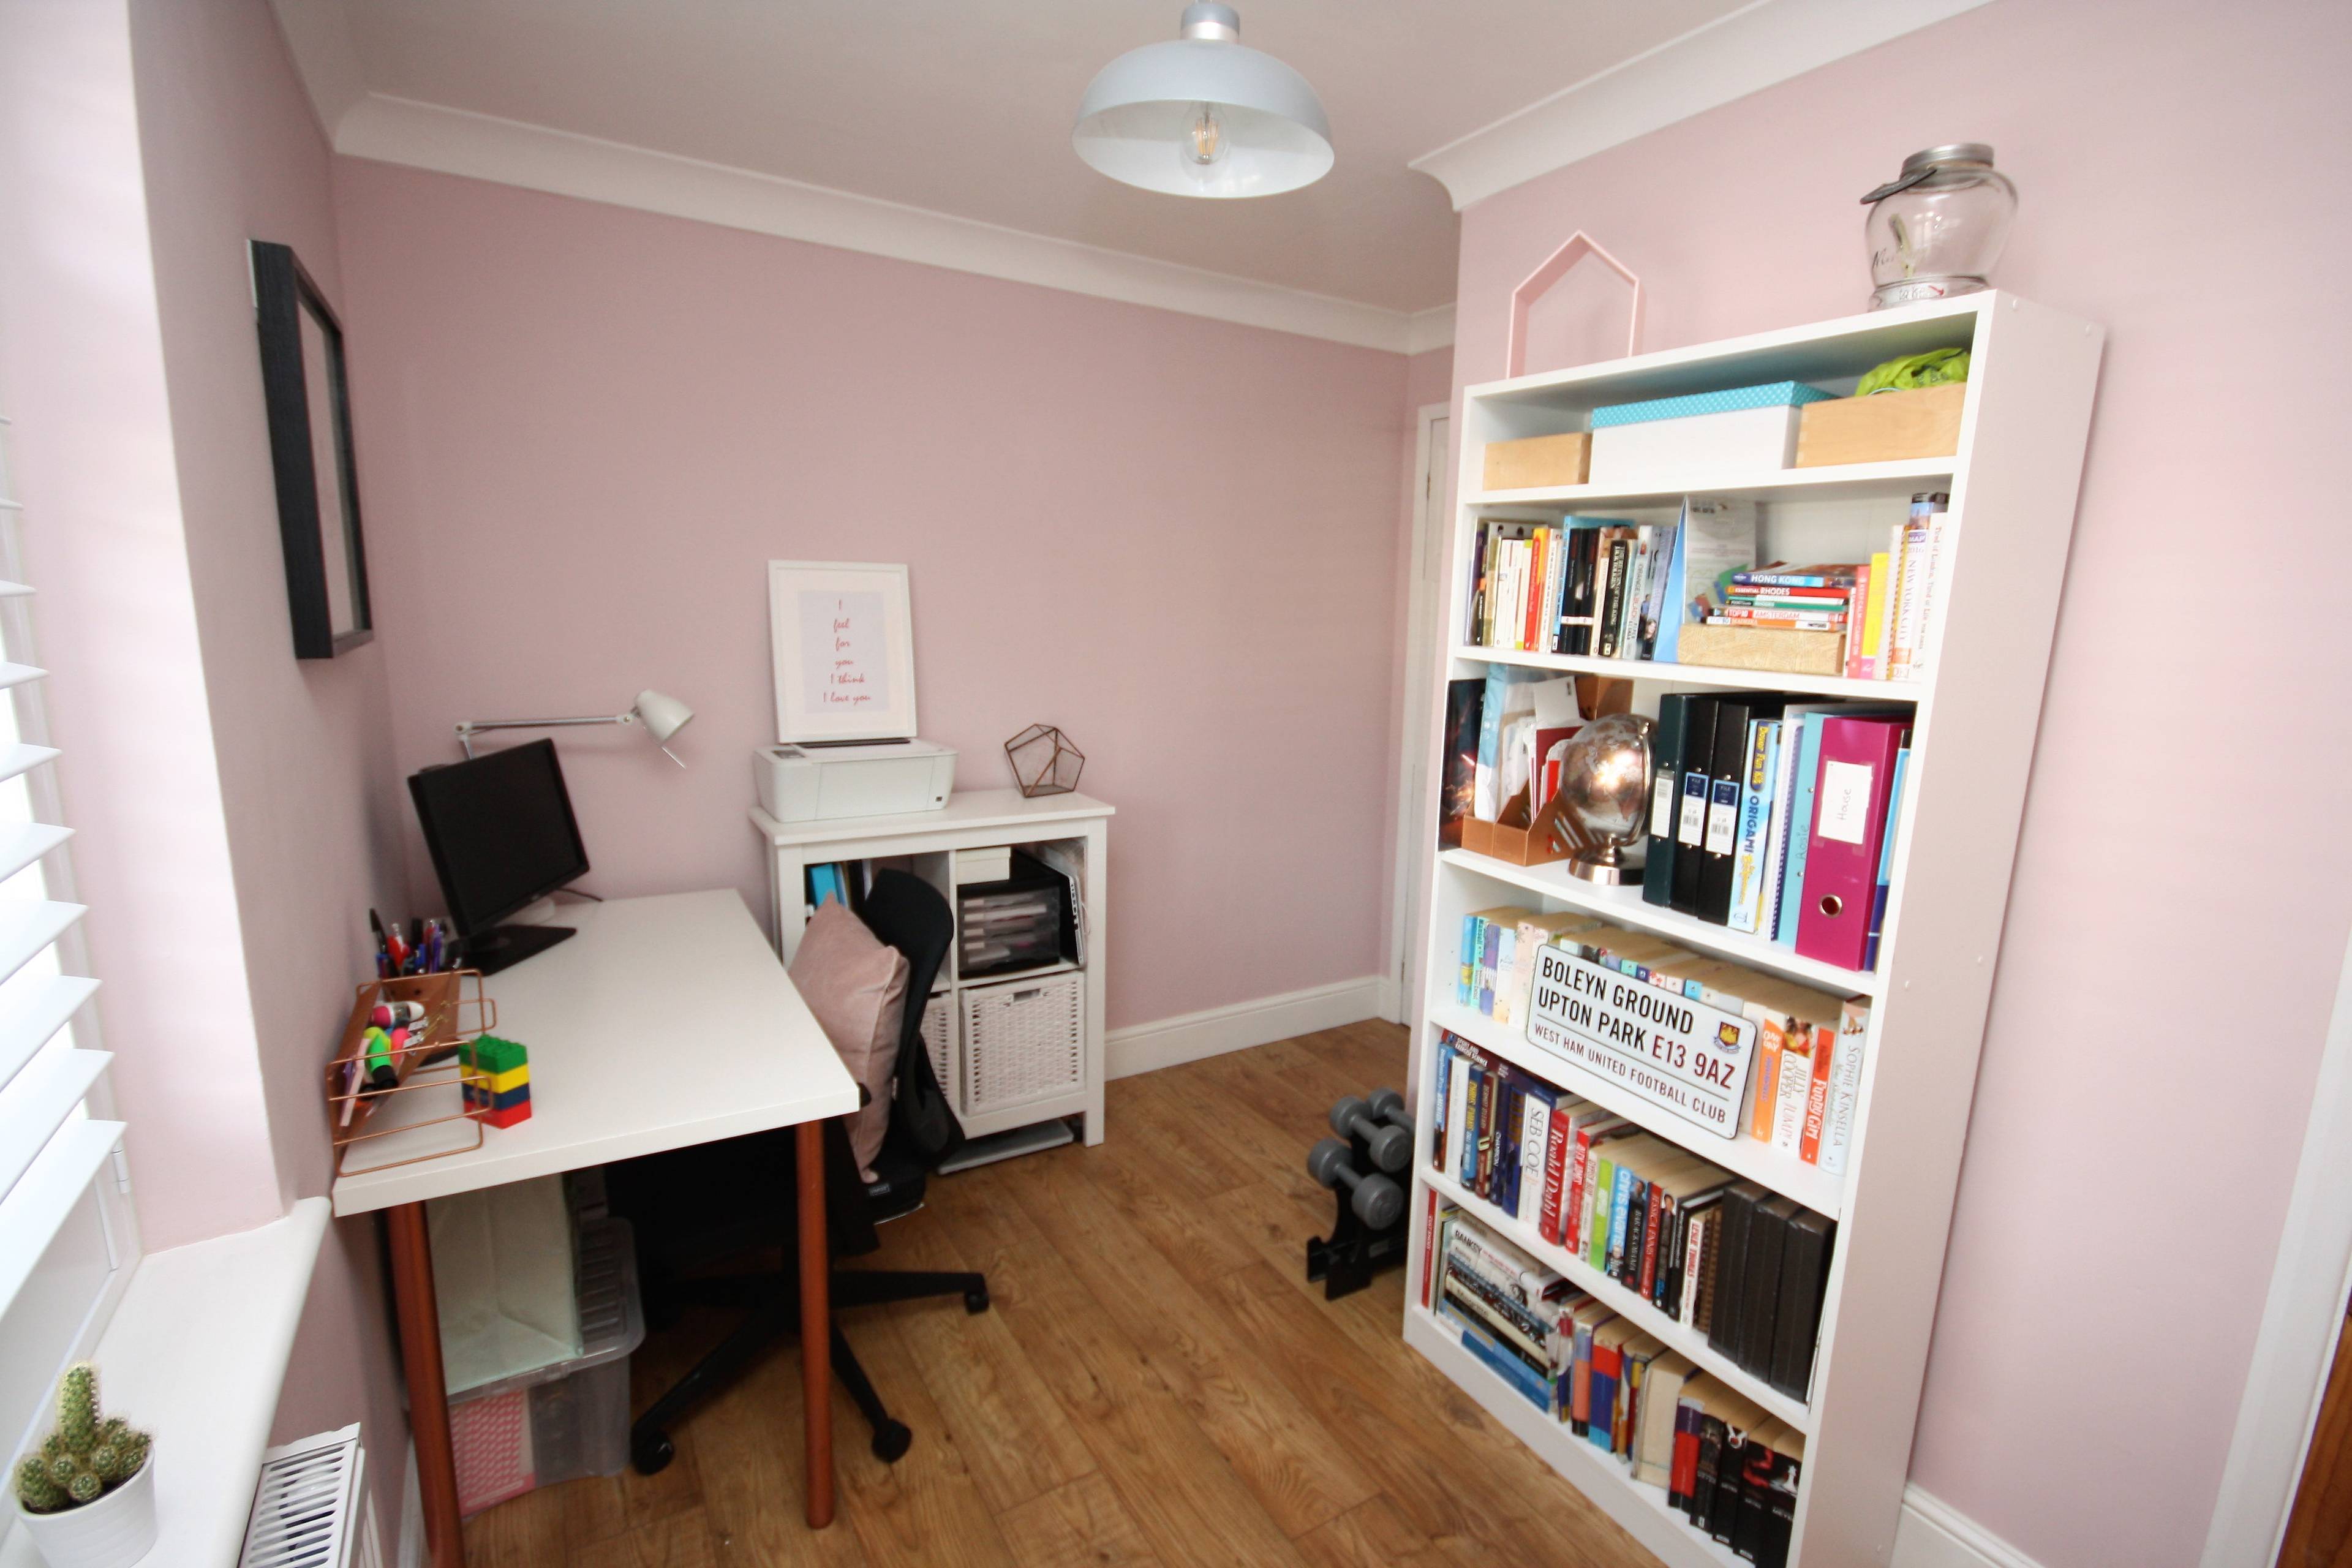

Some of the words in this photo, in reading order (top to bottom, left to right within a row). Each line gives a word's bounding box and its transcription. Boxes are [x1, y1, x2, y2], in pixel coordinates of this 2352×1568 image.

[1933, 527, 1942, 543] Tired
[1634, 564, 1644, 592] ORANGE
[1751, 574, 1777, 584] HONG
[1779, 576, 1805, 586] KONG
[1905, 560, 1917, 584] NEW
[838, 599, 842, 611] I
[1760, 587, 1790, 596] RHODES
[1902, 587, 1915, 616] YORK
[833, 617, 850, 633] feel
[1899, 617, 1909, 641] CITY
[835, 637, 850, 652] for
[831, 673, 834, 684] I
[838, 673, 865, 684] think
[835, 658, 854, 669] you
[823, 692, 826, 703] I
[830, 691, 850, 703] love
[852, 695, 871, 706] you
[1754, 753, 1765, 768] Fun
[1837, 788, 1852, 821] House
[1744, 795, 1759, 853] ORIGAMI
[1542, 956, 1608, 1001] BOLEYN
[1613, 984, 1694, 1035] GROUND
[1538, 986, 1593, 1028] UPTON
[1597, 1011, 1647, 1052] PARK
[1652, 1035, 1687, 1068] E13
[1694, 1052, 1736, 1090] 9AZ
[1534, 1023, 1560, 1044] WEST
[1563, 1036, 1585, 1057] HAM
[1588, 1048, 1626, 1077] UNITED
[1630, 1068, 1688, 1107] FOOTBALL
[1692, 1097, 1727, 1124] CLUB
[1779, 1054, 1796, 1099] COOPER
[1794, 1066, 1808, 1096] JILLY
[1845, 1046, 1861, 1087] SOPHIE
[1809, 1077, 1828, 1117] Funny
[1529, 1107, 1545, 1137] SEB
[1779, 1101, 1798, 1139] JUMP!
[1804, 1115, 1822, 1140] Girl
[1833, 1092, 1853, 1147] KINSELLA
[1525, 1140, 1542, 1178] COE
[1547, 1128, 1564, 1175] Roald
[1543, 1177, 1559, 1218] Dahl
[1618, 1171, 1631, 1204] chris
[1650, 1193, 1660, 1227] JESSICA
[1613, 1207, 1627, 1245] evans
[1632, 1210, 1642, 1241] BARACK
[1628, 1242, 1640, 1272] OBAMA
[1646, 1229, 1657, 1256] ENNIS
